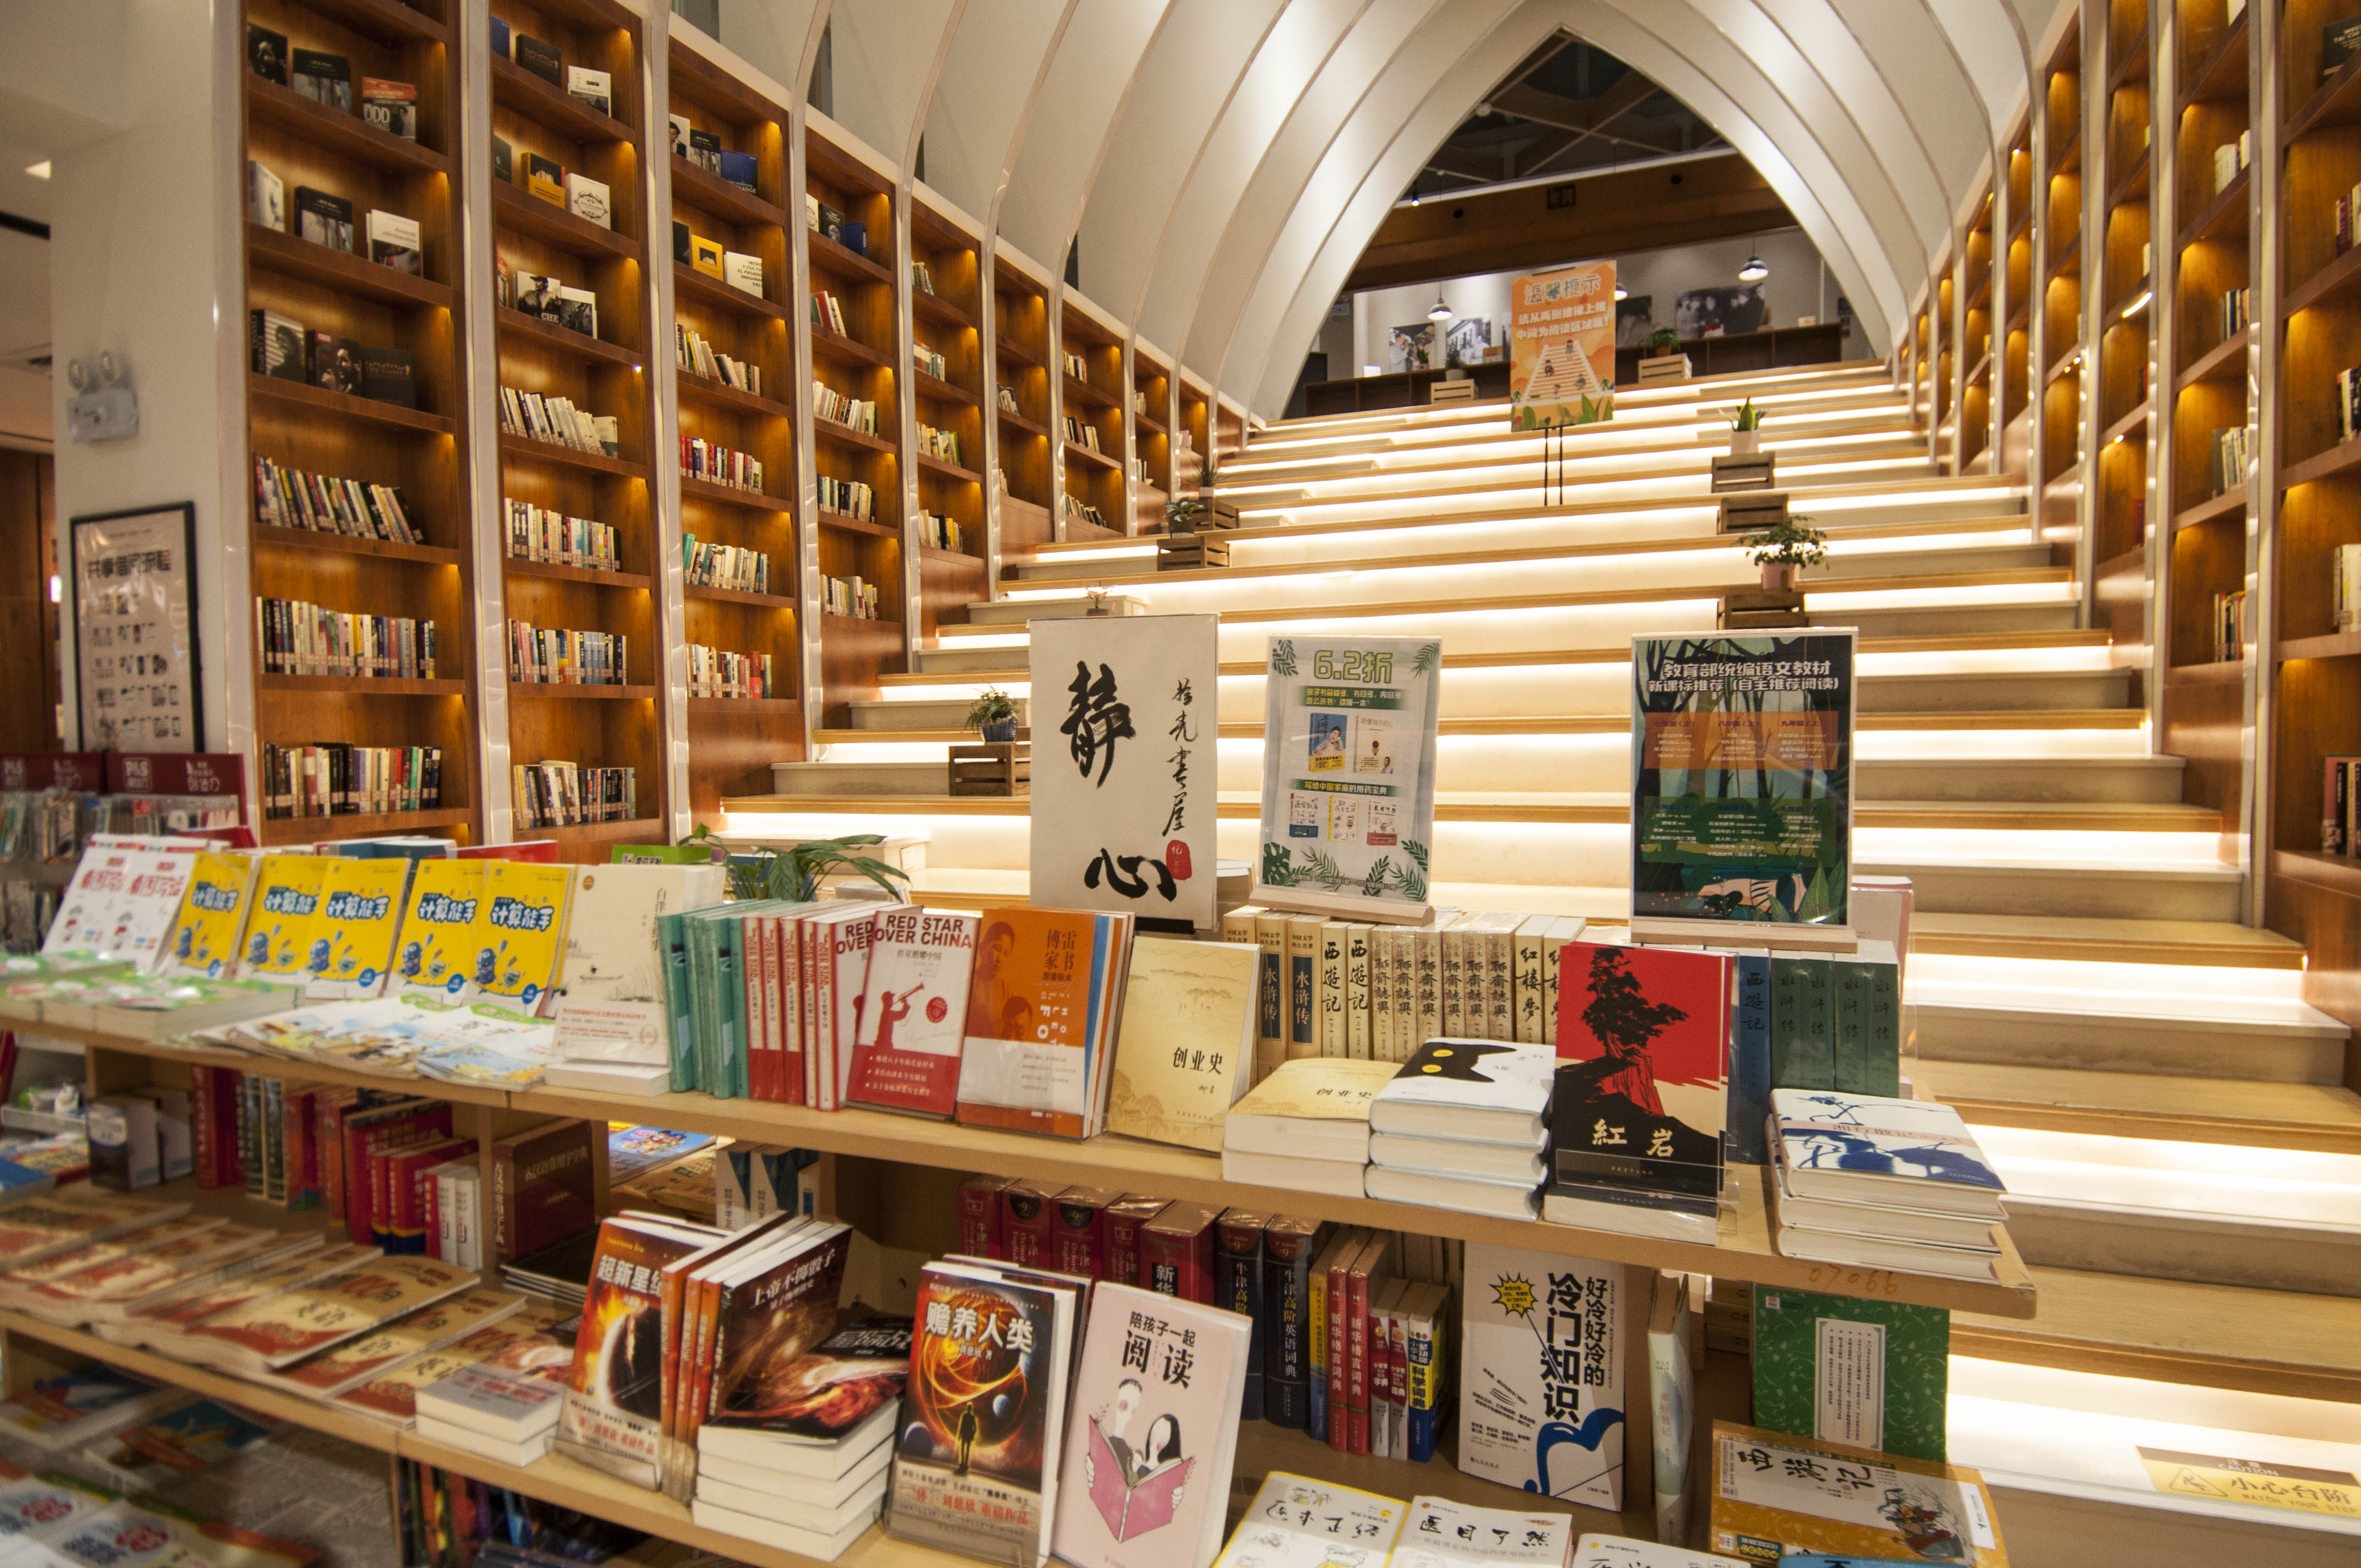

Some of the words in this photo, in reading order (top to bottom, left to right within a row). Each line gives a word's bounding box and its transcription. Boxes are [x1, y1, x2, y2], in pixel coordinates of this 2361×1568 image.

[363, 104, 390, 123] ODD
[1525, 274, 1601, 304] 温馨提示
[1314, 650, 1392, 684] 6.2折
[1663, 661, 1832, 678] 教育部统编语文教材
[1304, 781, 1388, 795] 写给中国家庭的用药宝典
[265, 890, 319, 914] 计算能
[327, 895, 390, 919] 计算能手
[418, 897, 477, 923] 计算能手
[491, 903, 554, 931] 计算能手
[845, 921, 874, 938] RED
[886, 915, 917, 929] RED
[922, 917, 964, 933] STAR
[873, 928, 916, 945] OVER
[921, 932, 972, 949] CHINA
[1047, 929, 1077, 950] 傅雷
[897, 949, 942, 961] 红星照耀中国
[1044, 951, 1076, 971] 家书
[1264, 967, 1277, 1021] 水浒传
[1295, 971, 1310, 1025] 水浒传
[1173, 1047, 1223, 1075] 创业史
[1316, 1088, 1372, 1099] 创业史
[1156, 1266, 1174, 1296] 新华
[1235, 1262, 1248, 1316] 牛津高阶
[925, 1300, 1033, 1354] 赡养人类
[1130, 1311, 1196, 1348] 陪孩子一起
[1283, 1270, 1297, 1378] 牛津高阶英语词典
[1584, 1276, 1608, 1386] 好冷好冷的
[959, 1343, 983, 1359] 刘慈欣
[1122, 1330, 1194, 1389] 阅读
[1331, 1314, 1342, 1391] 新华格言词典
[1351, 1318, 1362, 1396] 新华格言词典
[1540, 1272, 1584, 1424] 冷门知识
[1374, 1378, 1388, 1387] 字典
[1412, 1365, 1426, 1408] 科学词典
[1737, 1448, 1875, 1489] 西游记
[2218, 1463, 2279, 1477] CAUTION
[2231, 1477, 2352, 1505] 小心台阶
[2242, 1493, 2281, 1504] WATCH
[2289, 1499, 2318, 1510] YOUR
[2328, 1505, 2357, 1514] STEP
